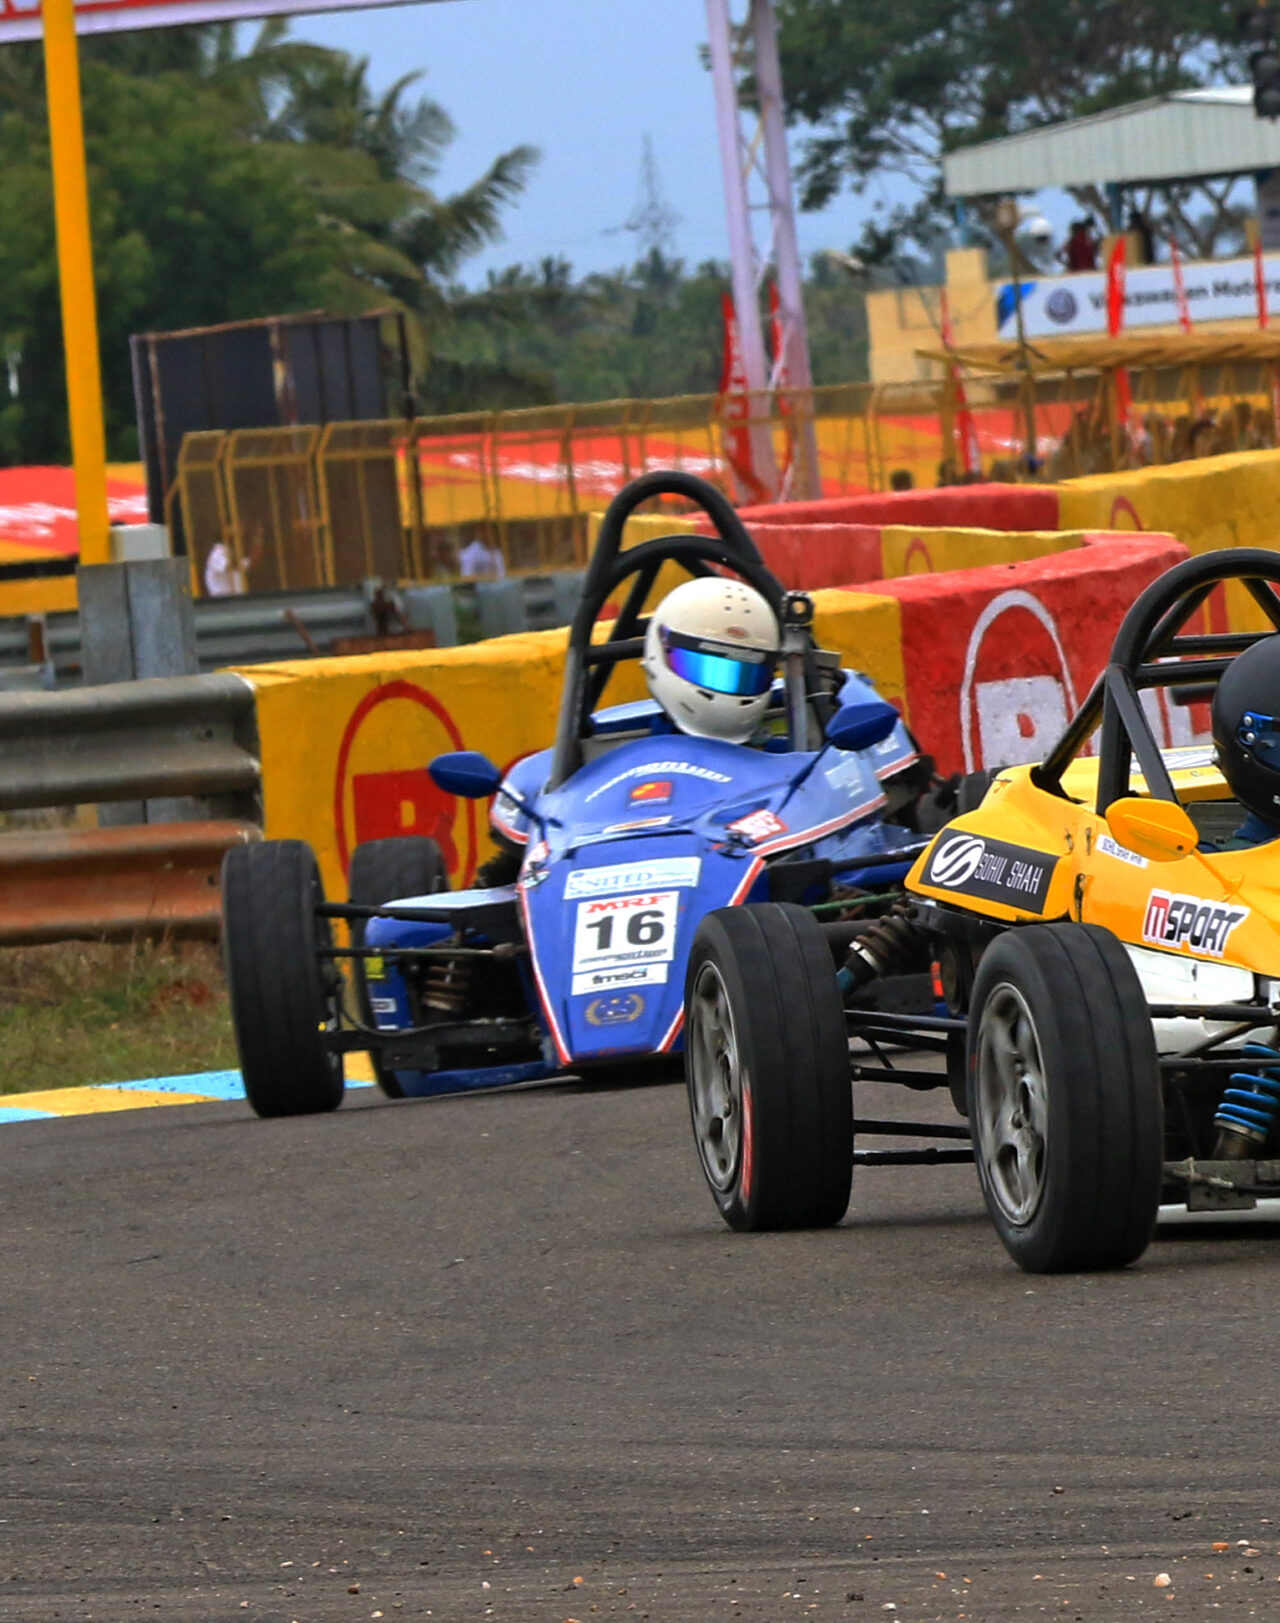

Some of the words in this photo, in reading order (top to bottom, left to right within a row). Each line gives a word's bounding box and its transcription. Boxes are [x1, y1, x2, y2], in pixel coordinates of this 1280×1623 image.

[974, 853, 1008, 885] SOHIL
[1006, 860, 1043, 894] SHAH
[586, 894, 671, 913] MRF
[585, 909, 665, 951] 16
